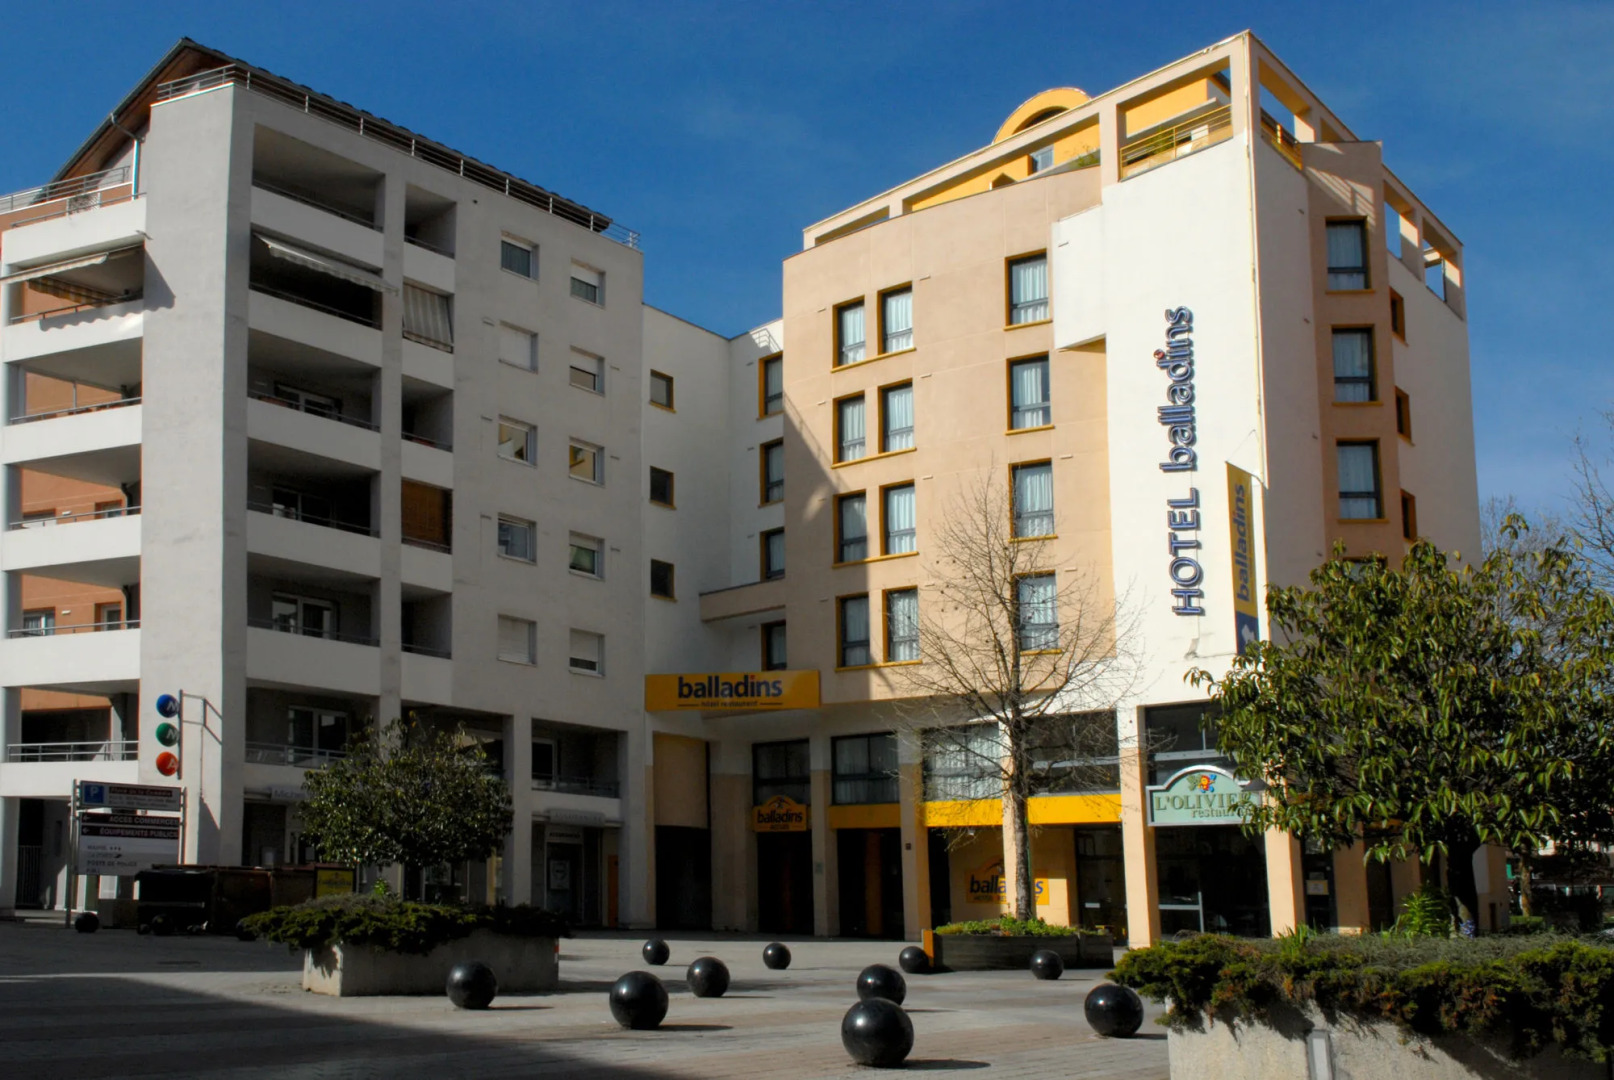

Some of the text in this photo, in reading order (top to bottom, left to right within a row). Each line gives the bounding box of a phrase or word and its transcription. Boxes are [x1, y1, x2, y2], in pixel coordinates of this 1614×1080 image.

[1153, 305, 1202, 616] HOTEL balladins
[1232, 483, 1250, 602] balladins
[678, 674, 783, 699] balladins
[90, 786, 99, 797] P
[757, 809, 803, 824] balladins
[1191, 808, 1255, 819] restaur
[970, 874, 1044, 895] ballas
